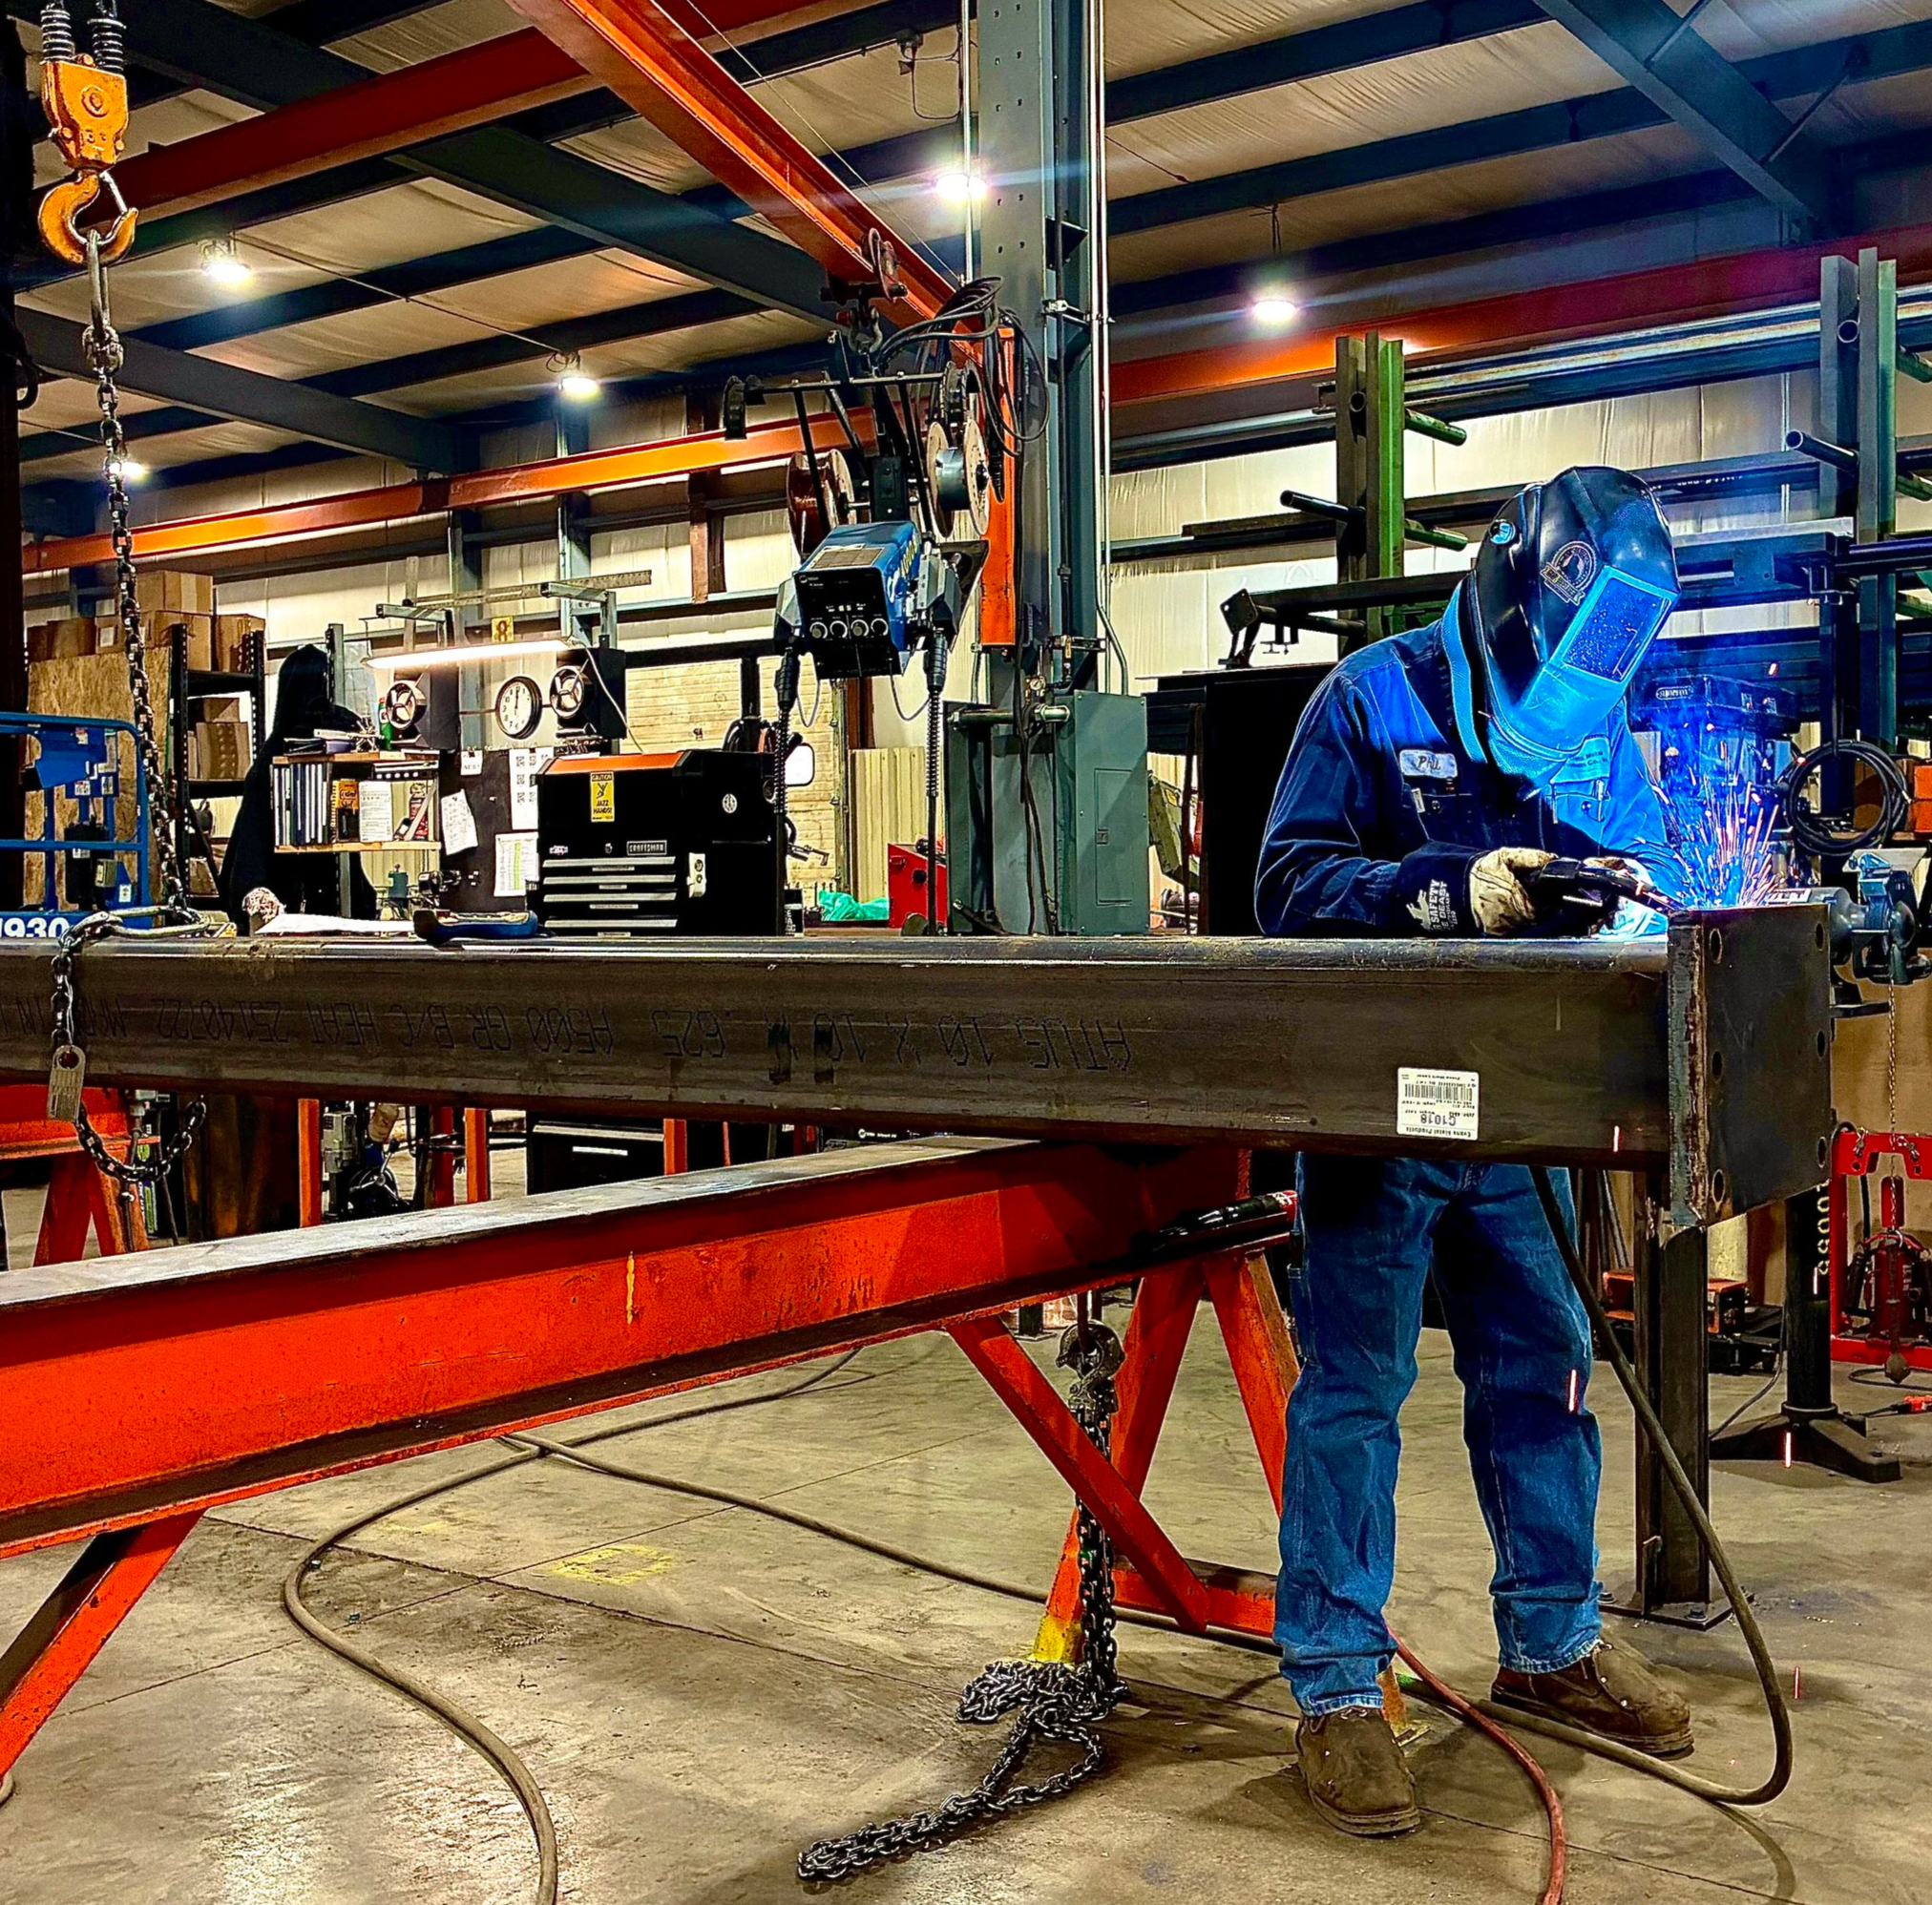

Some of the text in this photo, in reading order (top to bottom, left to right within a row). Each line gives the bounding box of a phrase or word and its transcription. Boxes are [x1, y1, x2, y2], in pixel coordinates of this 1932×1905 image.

[1418, 755, 1441, 770] Phil
[592, 773, 613, 782] CAUTION
[596, 799, 610, 807] JAZZ
[628, 843, 665, 853] CRAFTSMAN
[1429, 878, 1440, 923] SAFETY
[0, 917, 71, 938] 930
[305, 1000, 381, 1047] HEAT
[466, 1004, 512, 1053] GR
[526, 1006, 615, 1057] A500
[812, 1012, 867, 1064] 10
[936, 1015, 995, 1068] 10
[1406, 1126, 1433, 1135] Products
[1419, 1114, 1457, 1126] C1018
